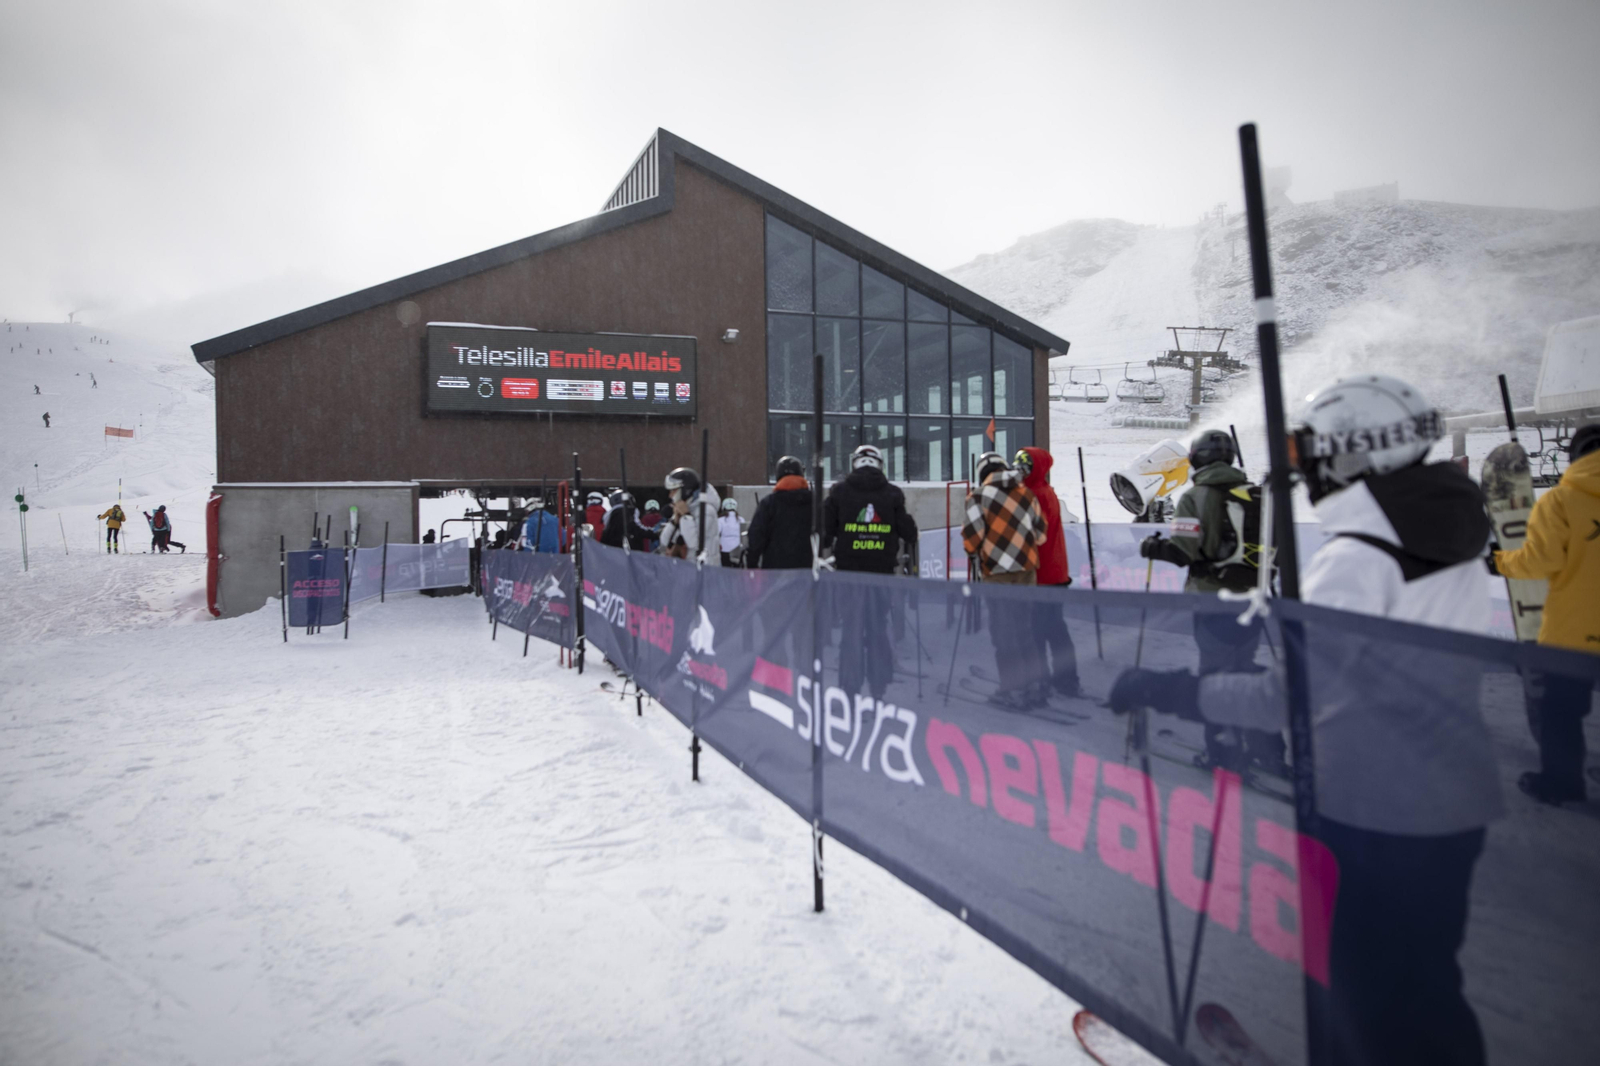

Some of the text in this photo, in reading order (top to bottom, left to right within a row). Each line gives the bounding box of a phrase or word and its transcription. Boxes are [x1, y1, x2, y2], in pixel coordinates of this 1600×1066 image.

[852, 540, 886, 550] DUBAI
[293, 579, 340, 589] ACCESO
[796, 659, 1340, 990] sierra nevada
